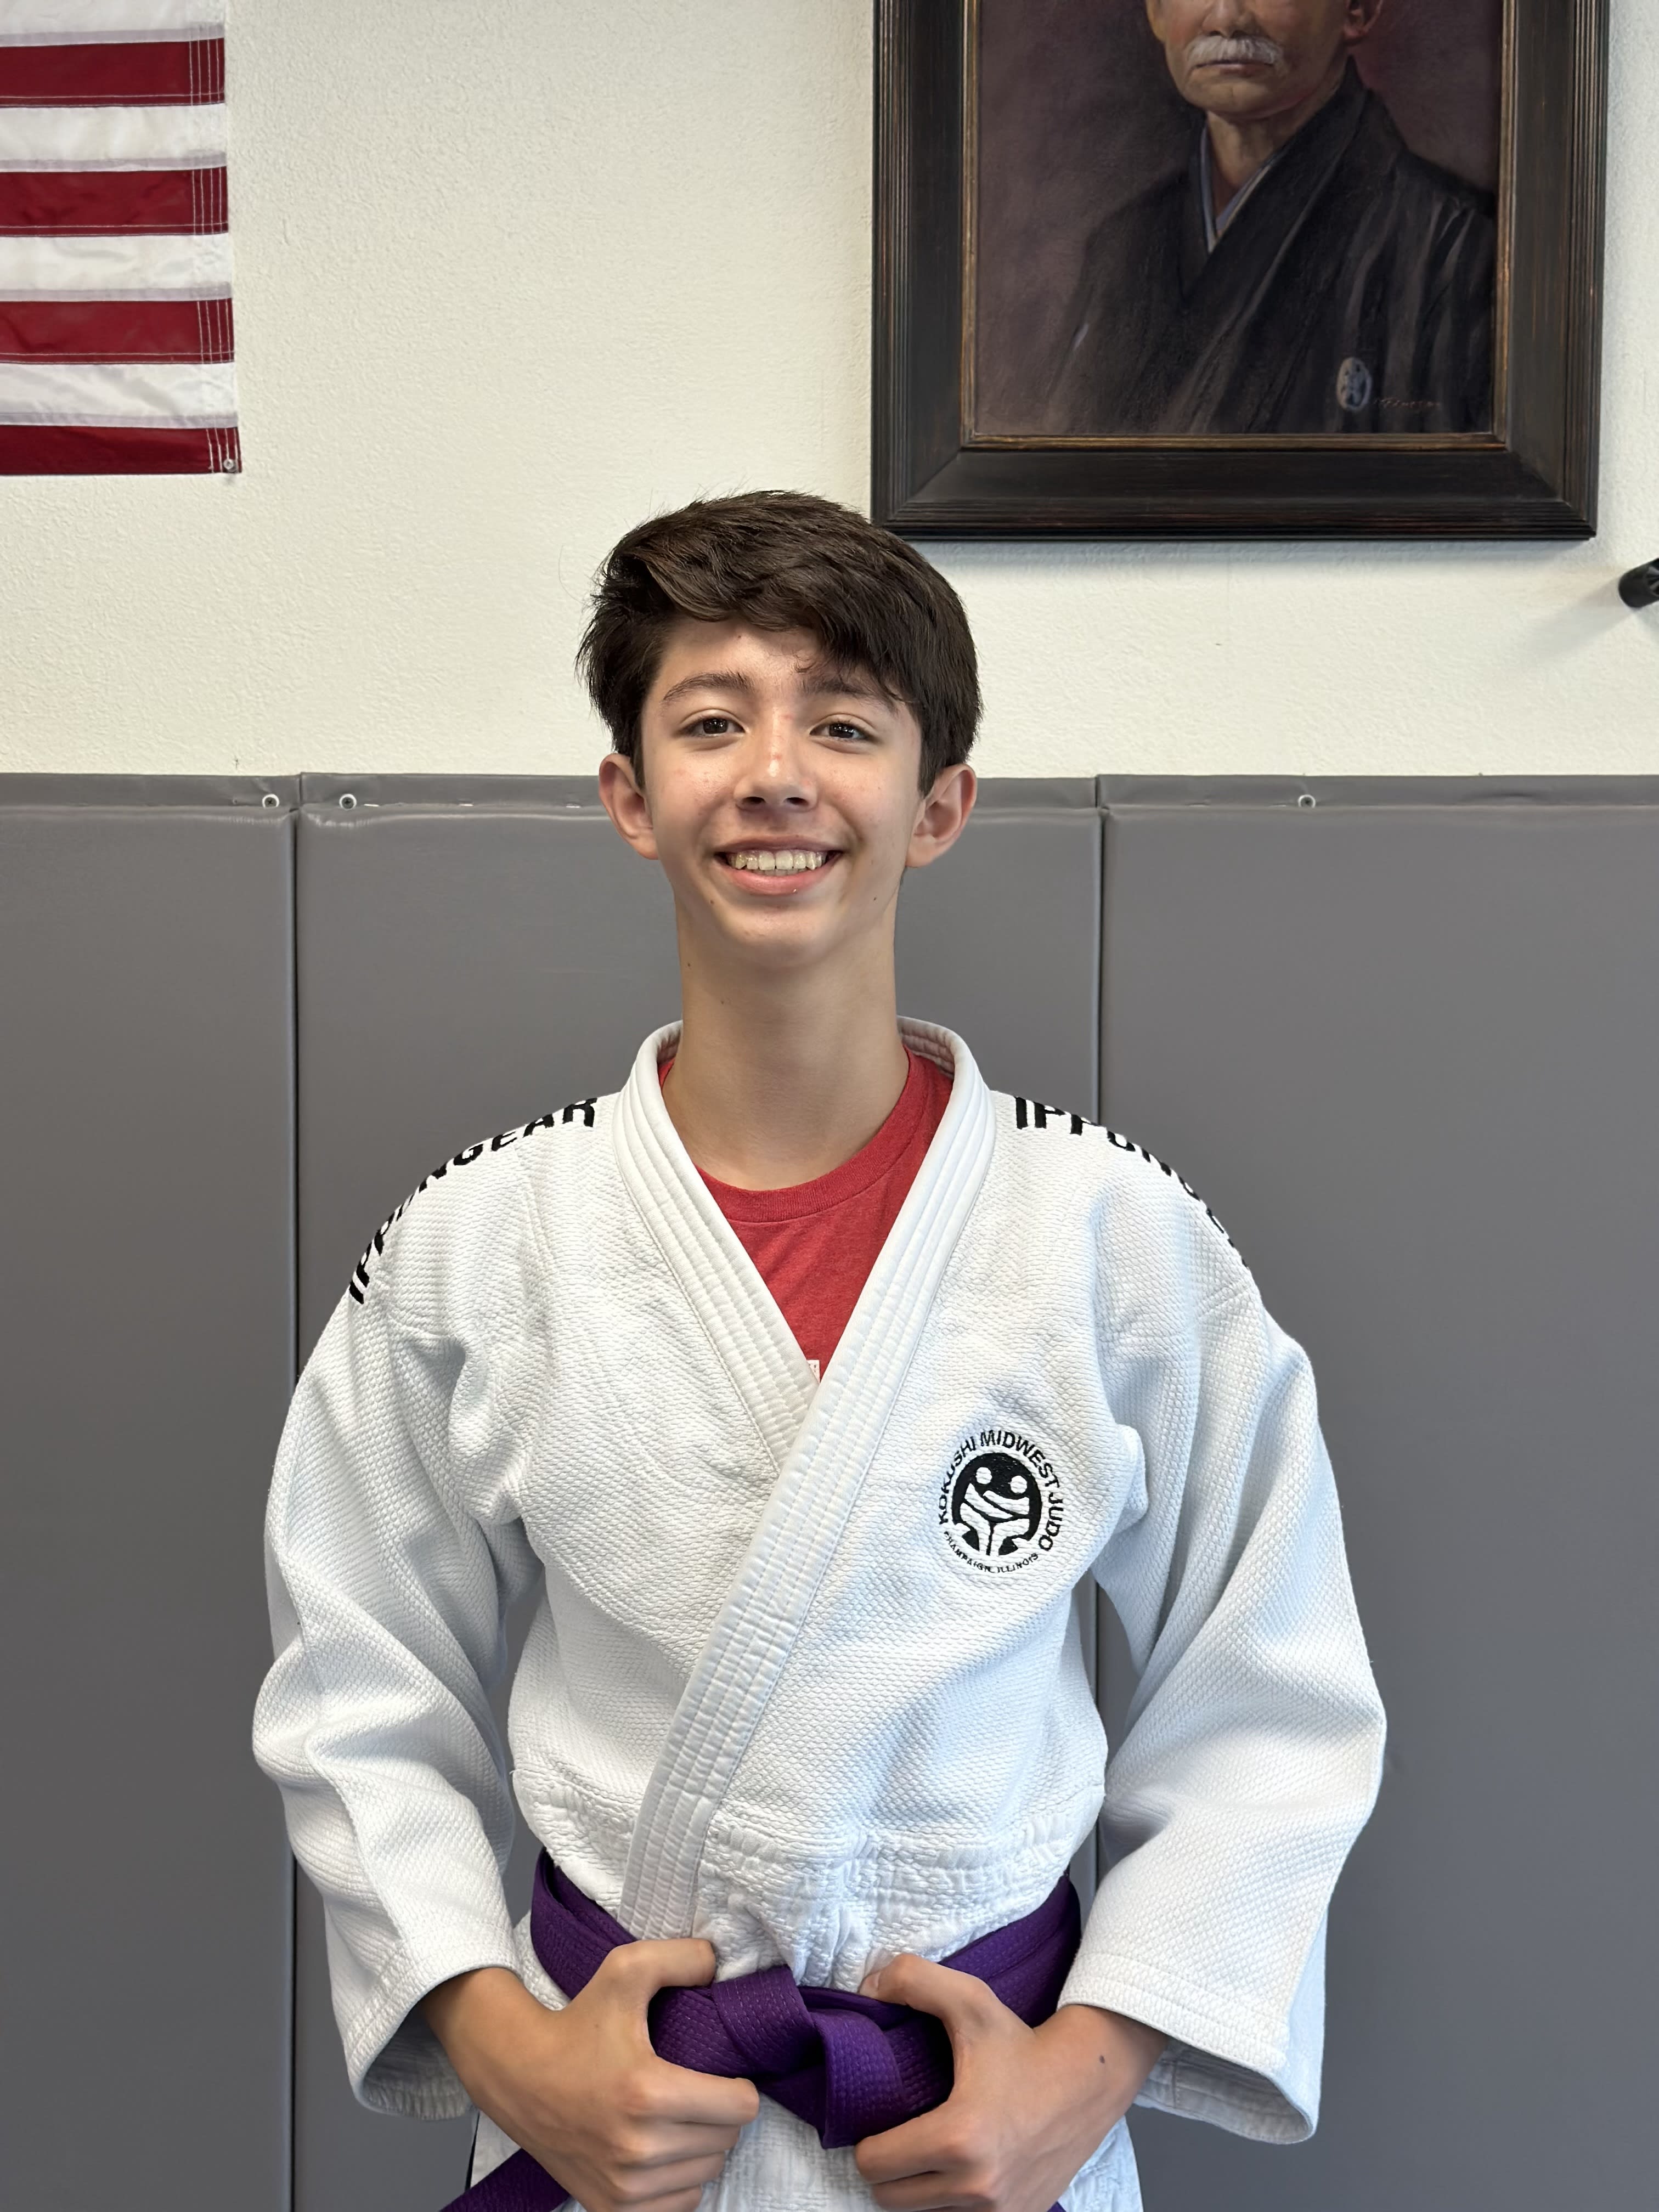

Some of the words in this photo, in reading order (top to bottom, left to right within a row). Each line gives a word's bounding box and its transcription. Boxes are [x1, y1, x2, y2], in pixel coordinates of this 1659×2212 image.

[939, 1436, 976, 1525] KOKUSHI
[980, 1429, 1060, 1488] MIDWEST
[1039, 1492, 1064, 1551] JUDO
[997, 1553, 1039, 1573] ILLINOIS
